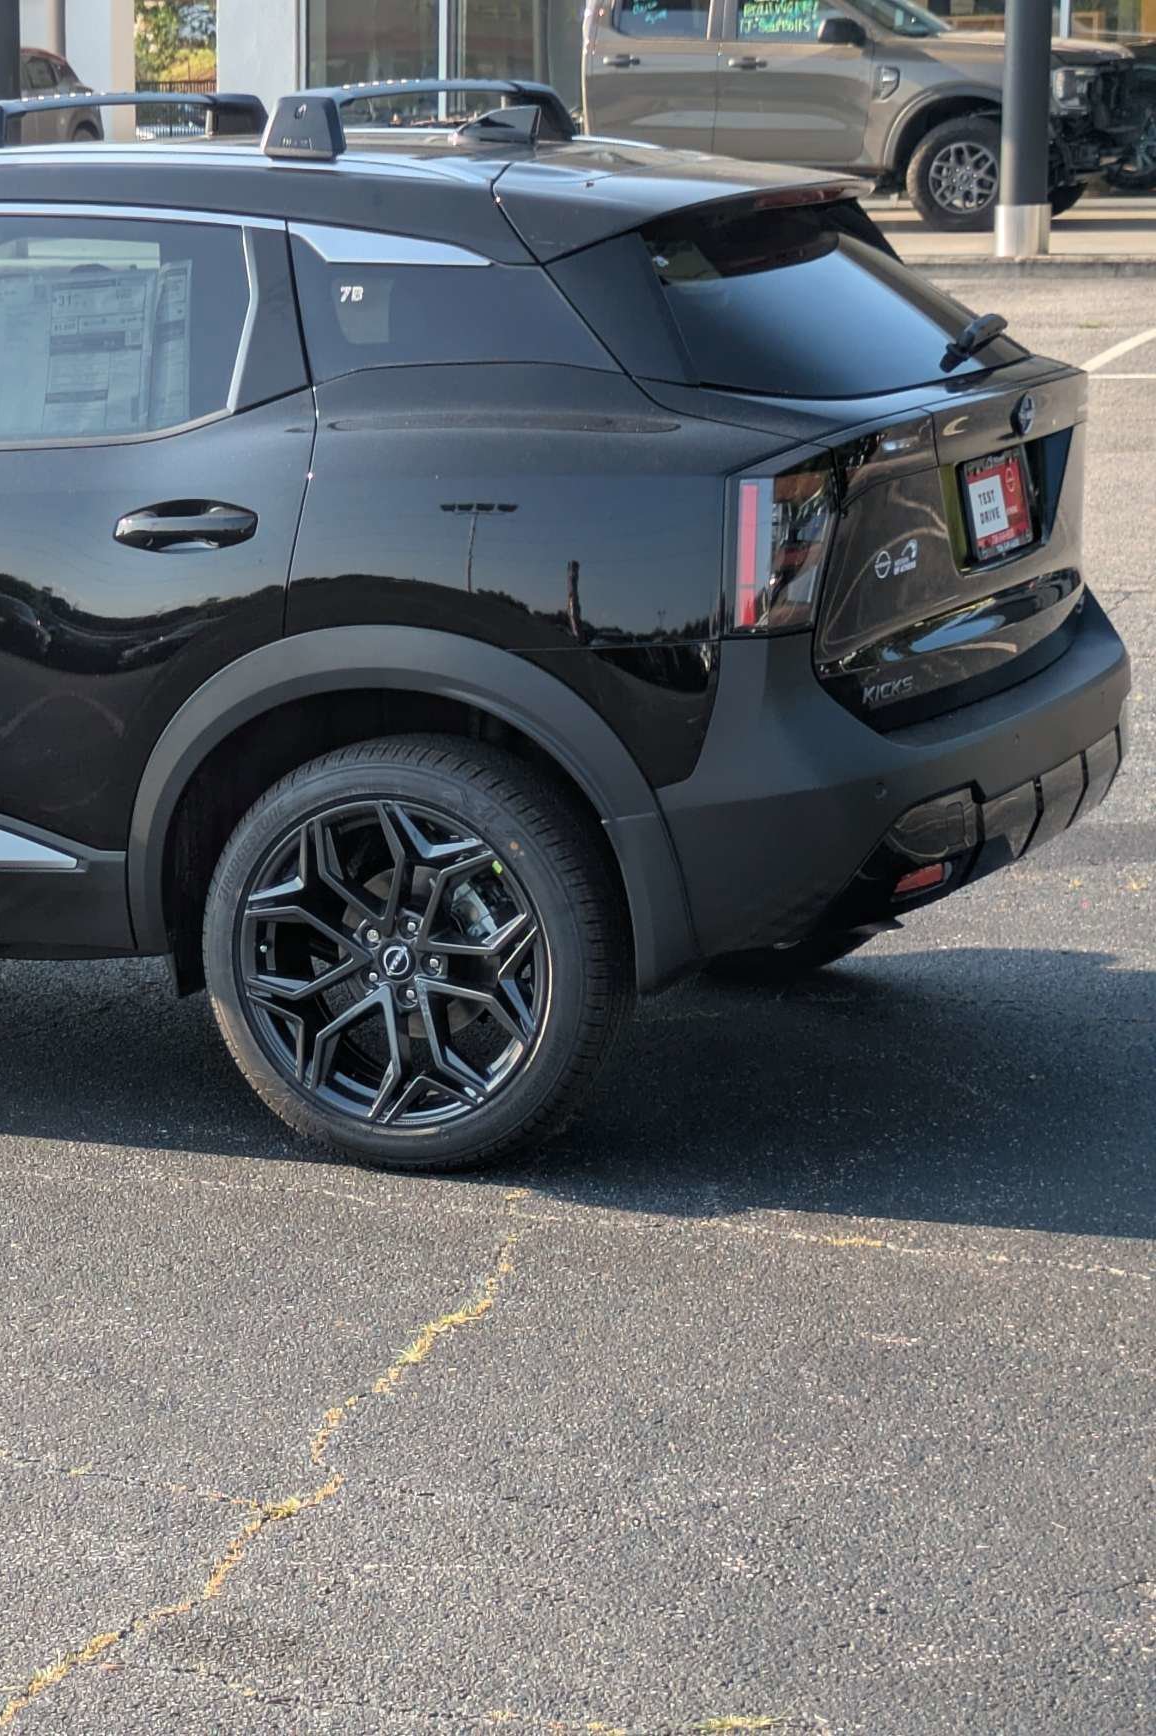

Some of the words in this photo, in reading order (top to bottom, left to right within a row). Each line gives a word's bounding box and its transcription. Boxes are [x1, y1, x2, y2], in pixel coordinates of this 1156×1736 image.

[978, 490, 996, 505] TEST
[979, 507, 1001, 525] DRIVE
[862, 675, 914, 704] KICKS
